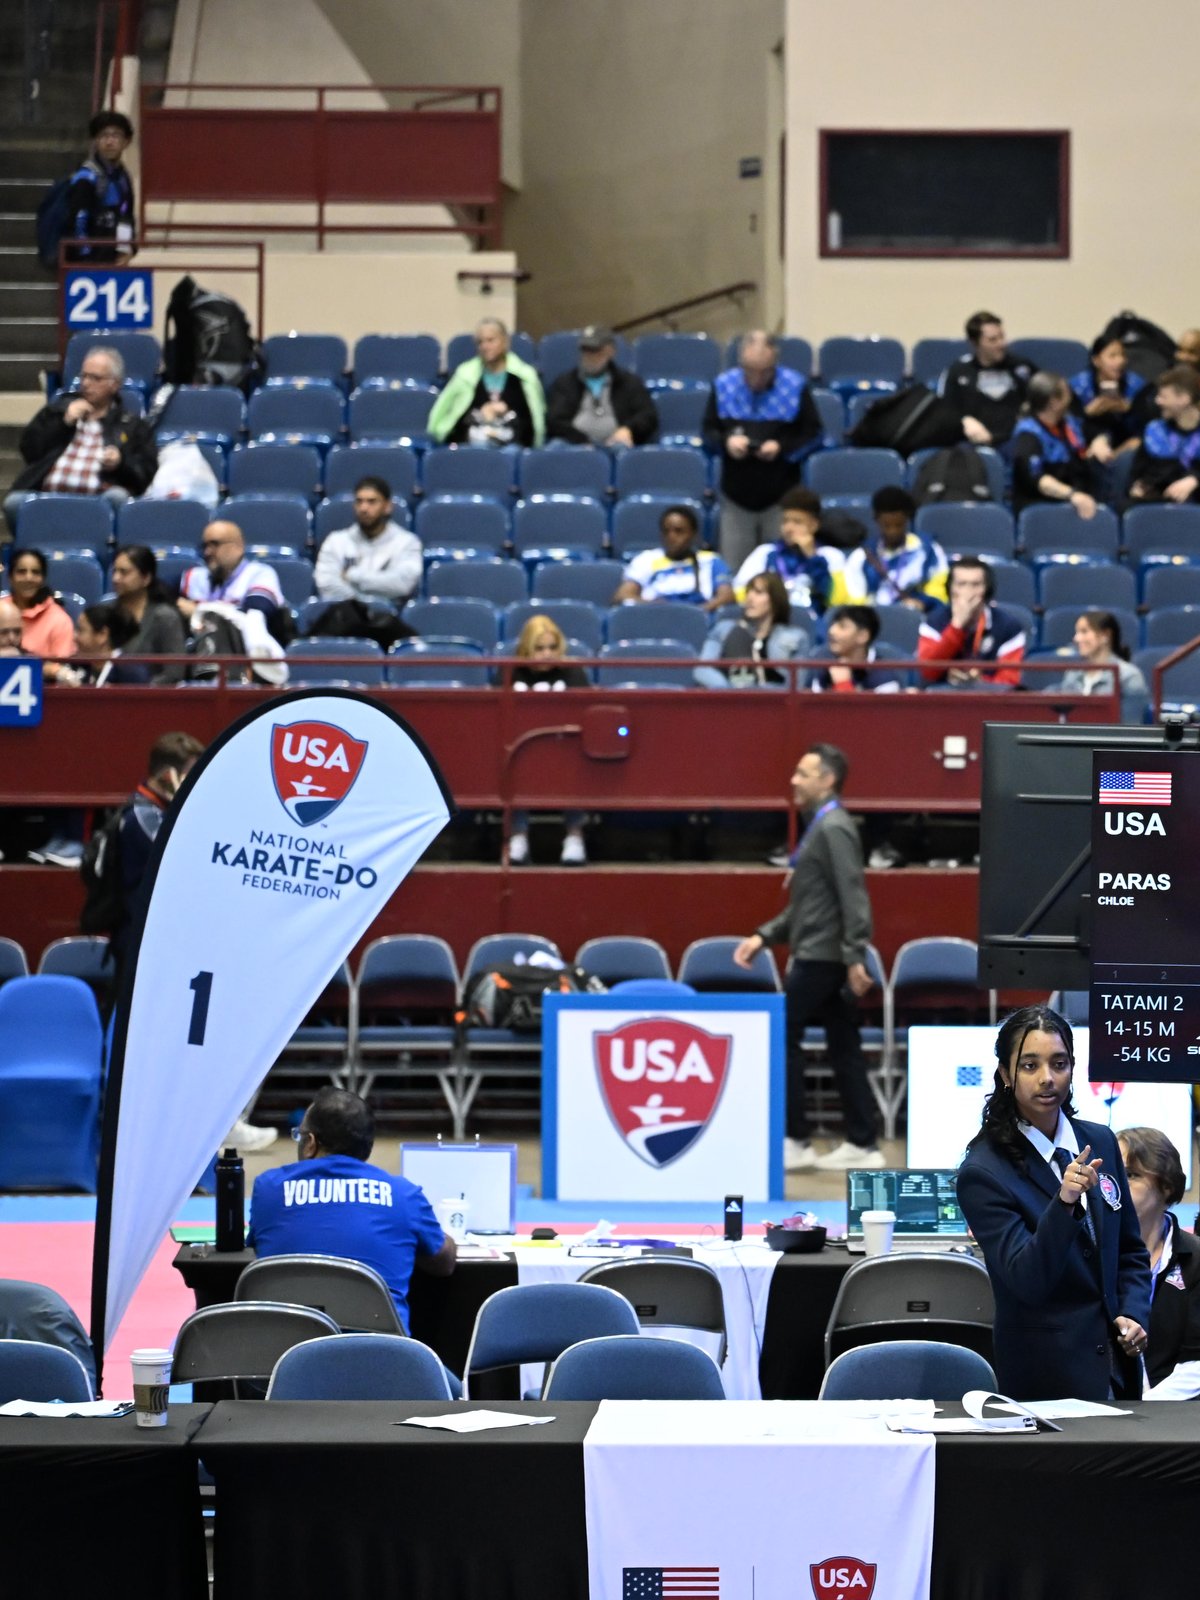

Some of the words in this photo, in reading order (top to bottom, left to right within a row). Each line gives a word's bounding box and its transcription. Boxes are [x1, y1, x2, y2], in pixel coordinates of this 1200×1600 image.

[69, 277, 150, 322] 214
[0, 665, 37, 716] 4
[282, 732, 350, 773] USA
[1104, 811, 1166, 836] USA
[250, 830, 347, 859] NATIONAL
[211, 842, 378, 889] KARATE-DO
[242, 874, 341, 900] FEDERATION
[1099, 873, 1171, 890] PARAS
[1098, 896, 1135, 906] CHLOE
[1161, 971, 1168, 980] 2
[187, 970, 214, 1046] 1
[1101, 994, 1168, 1011] TATAMI
[1173, 996, 1184, 1011] 2
[1105, 1020, 1153, 1037] 14-15
[1159, 1021, 1175, 1037] M
[610, 1037, 714, 1083] USA
[1113, 1046, 1142, 1062] -54
[1147, 1047, 1171, 1062] KG
[283, 1178, 392, 1207] VOLUNTEER
[819, 1568, 867, 1588] USA
